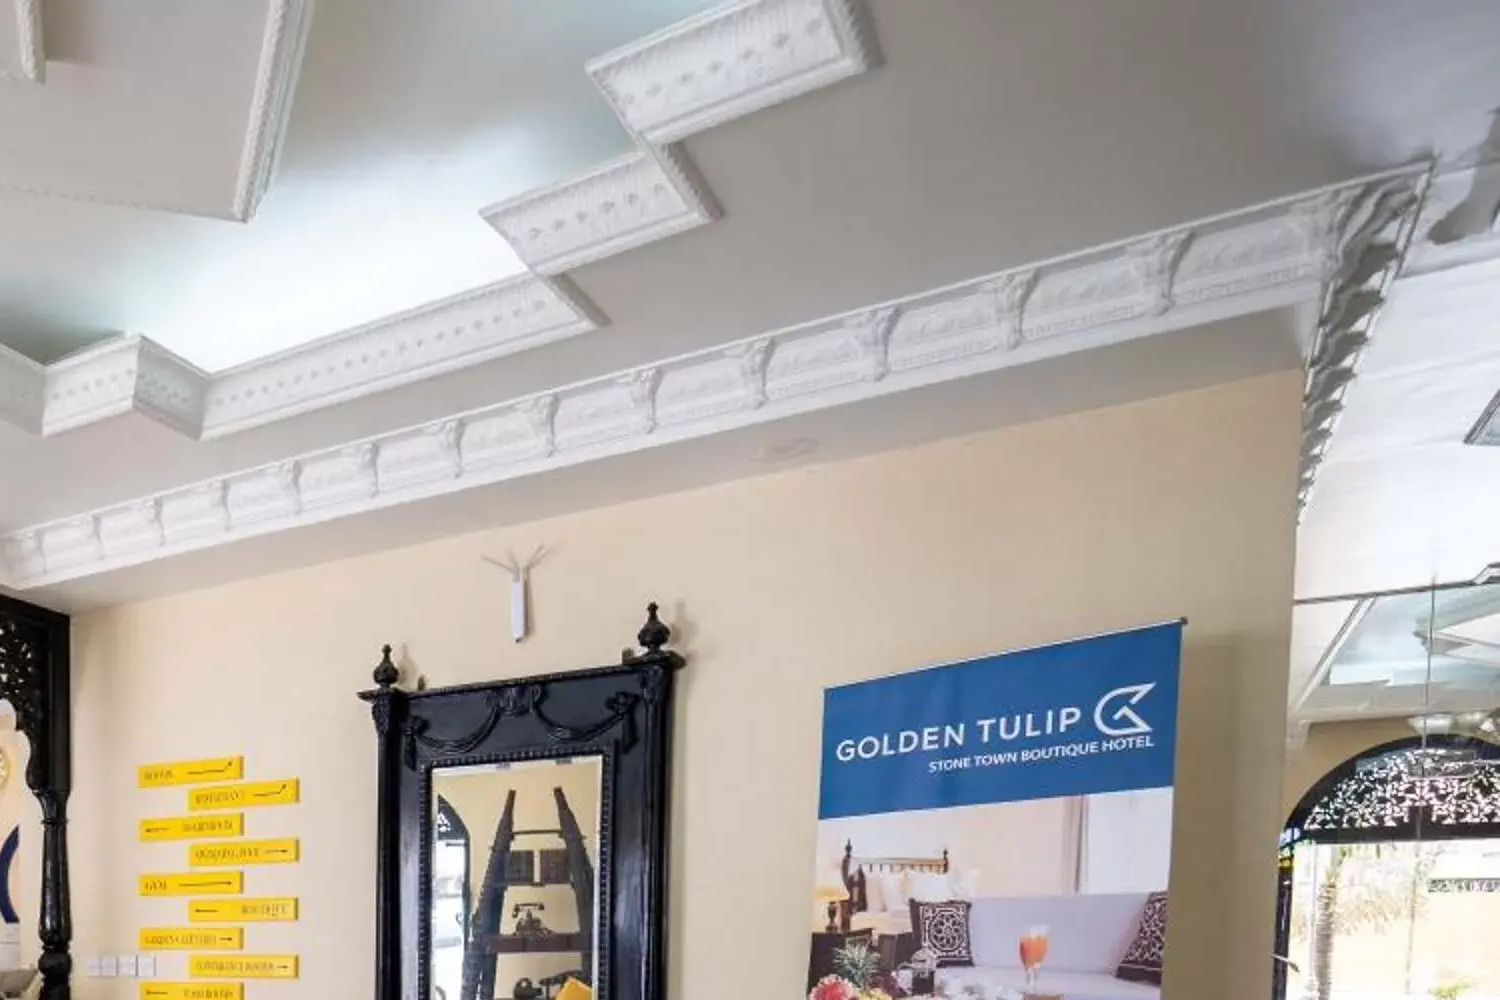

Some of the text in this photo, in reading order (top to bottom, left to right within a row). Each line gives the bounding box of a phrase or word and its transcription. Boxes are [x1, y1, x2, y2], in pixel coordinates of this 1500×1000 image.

[835, 706, 1082, 762] GOLDEN TULIP
[928, 734, 1155, 773] STONE TOWN BOUTIQUE HOTEL
